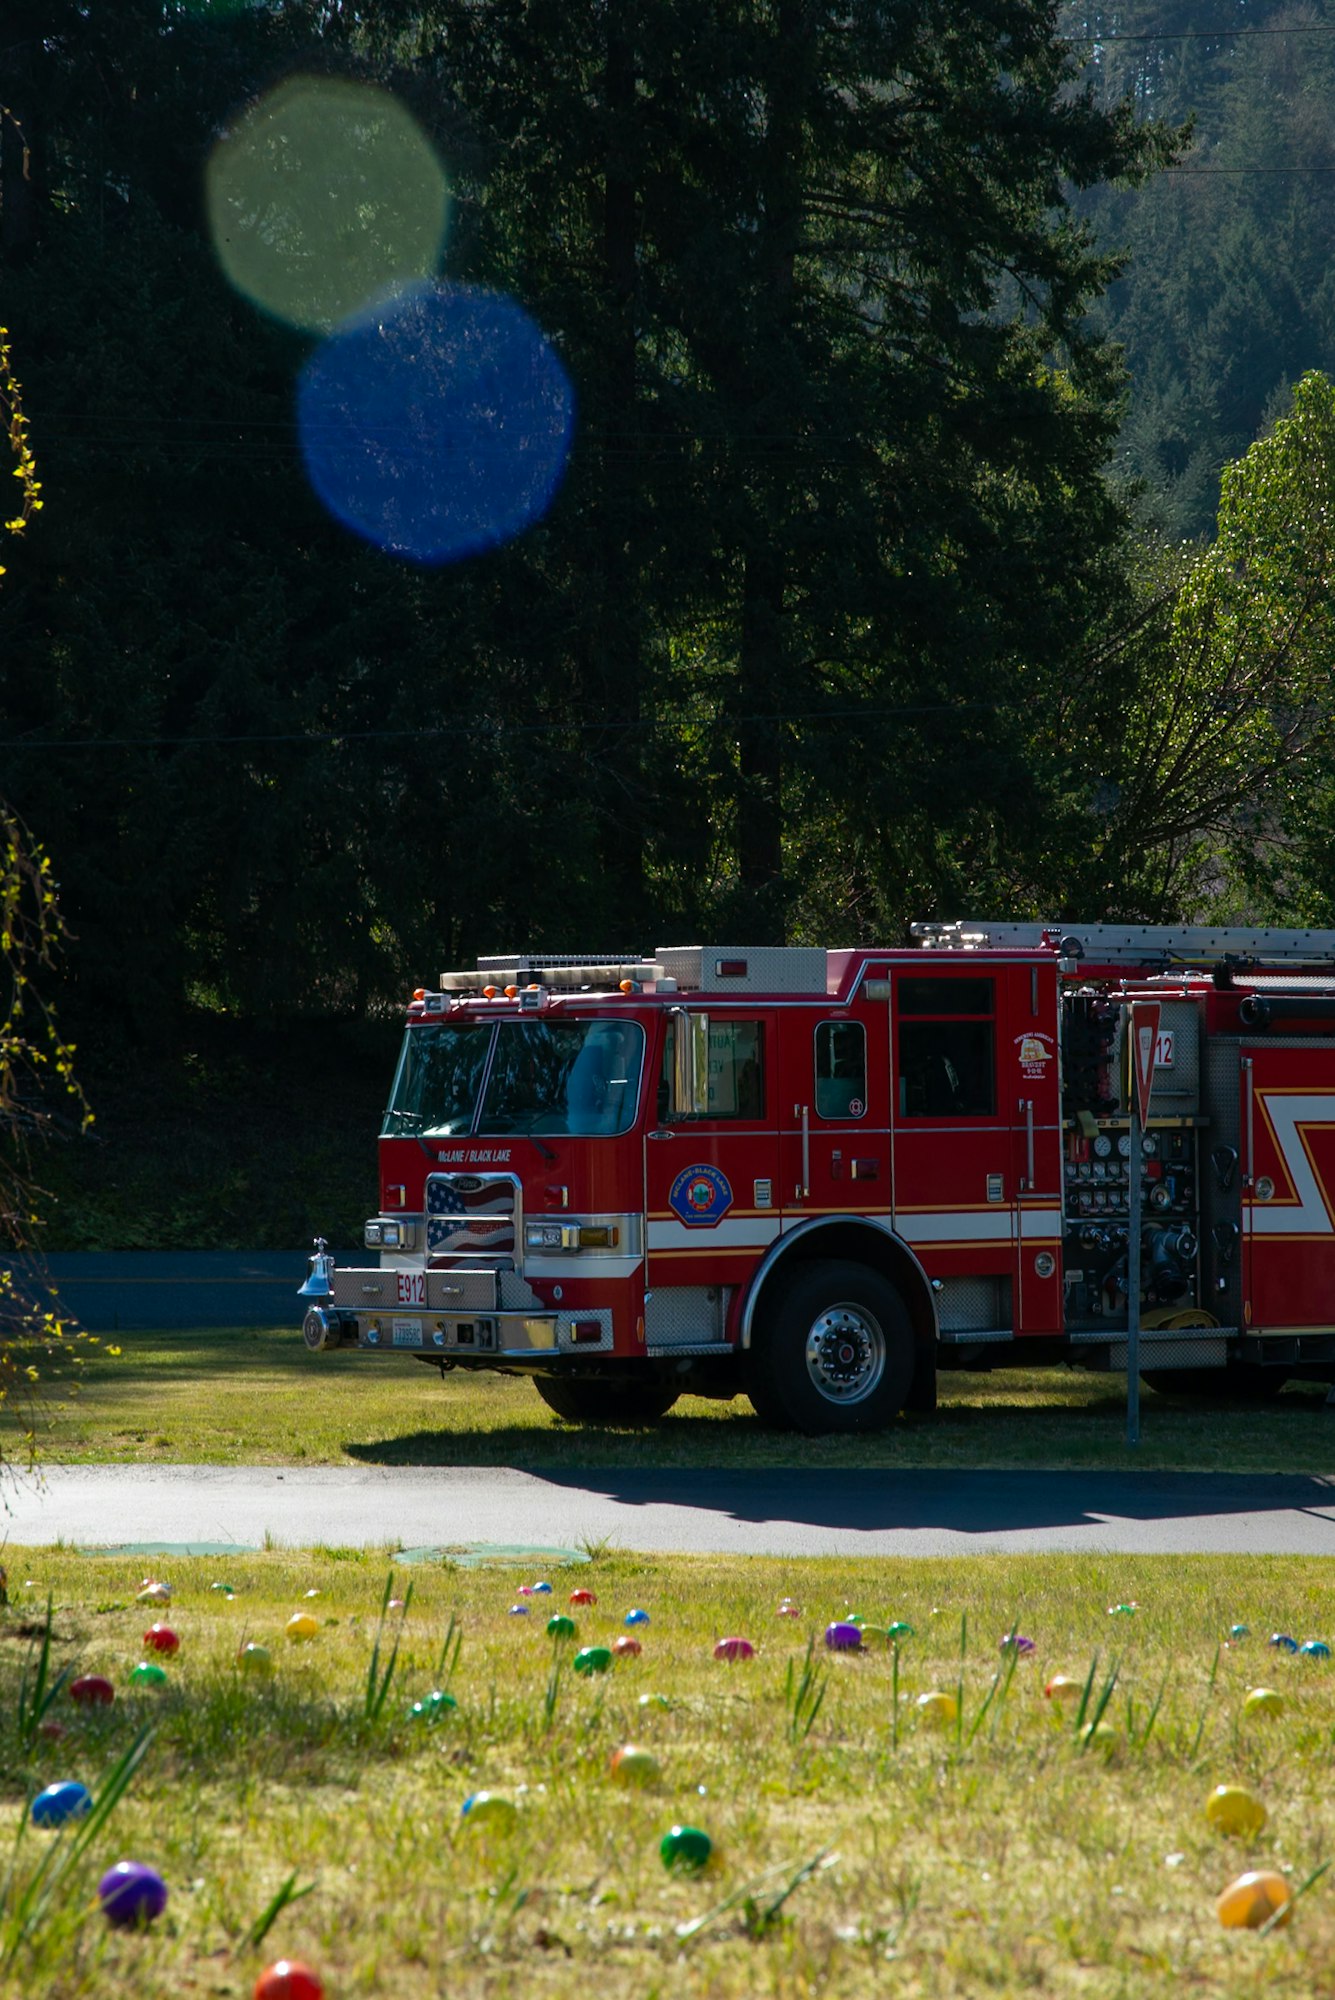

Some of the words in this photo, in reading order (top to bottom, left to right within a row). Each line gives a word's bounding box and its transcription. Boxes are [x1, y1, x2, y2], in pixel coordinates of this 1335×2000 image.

[469, 1149, 493, 1162] BLACK
[492, 1148, 512, 1162] LAKE
[397, 1274, 425, 1303] E912
